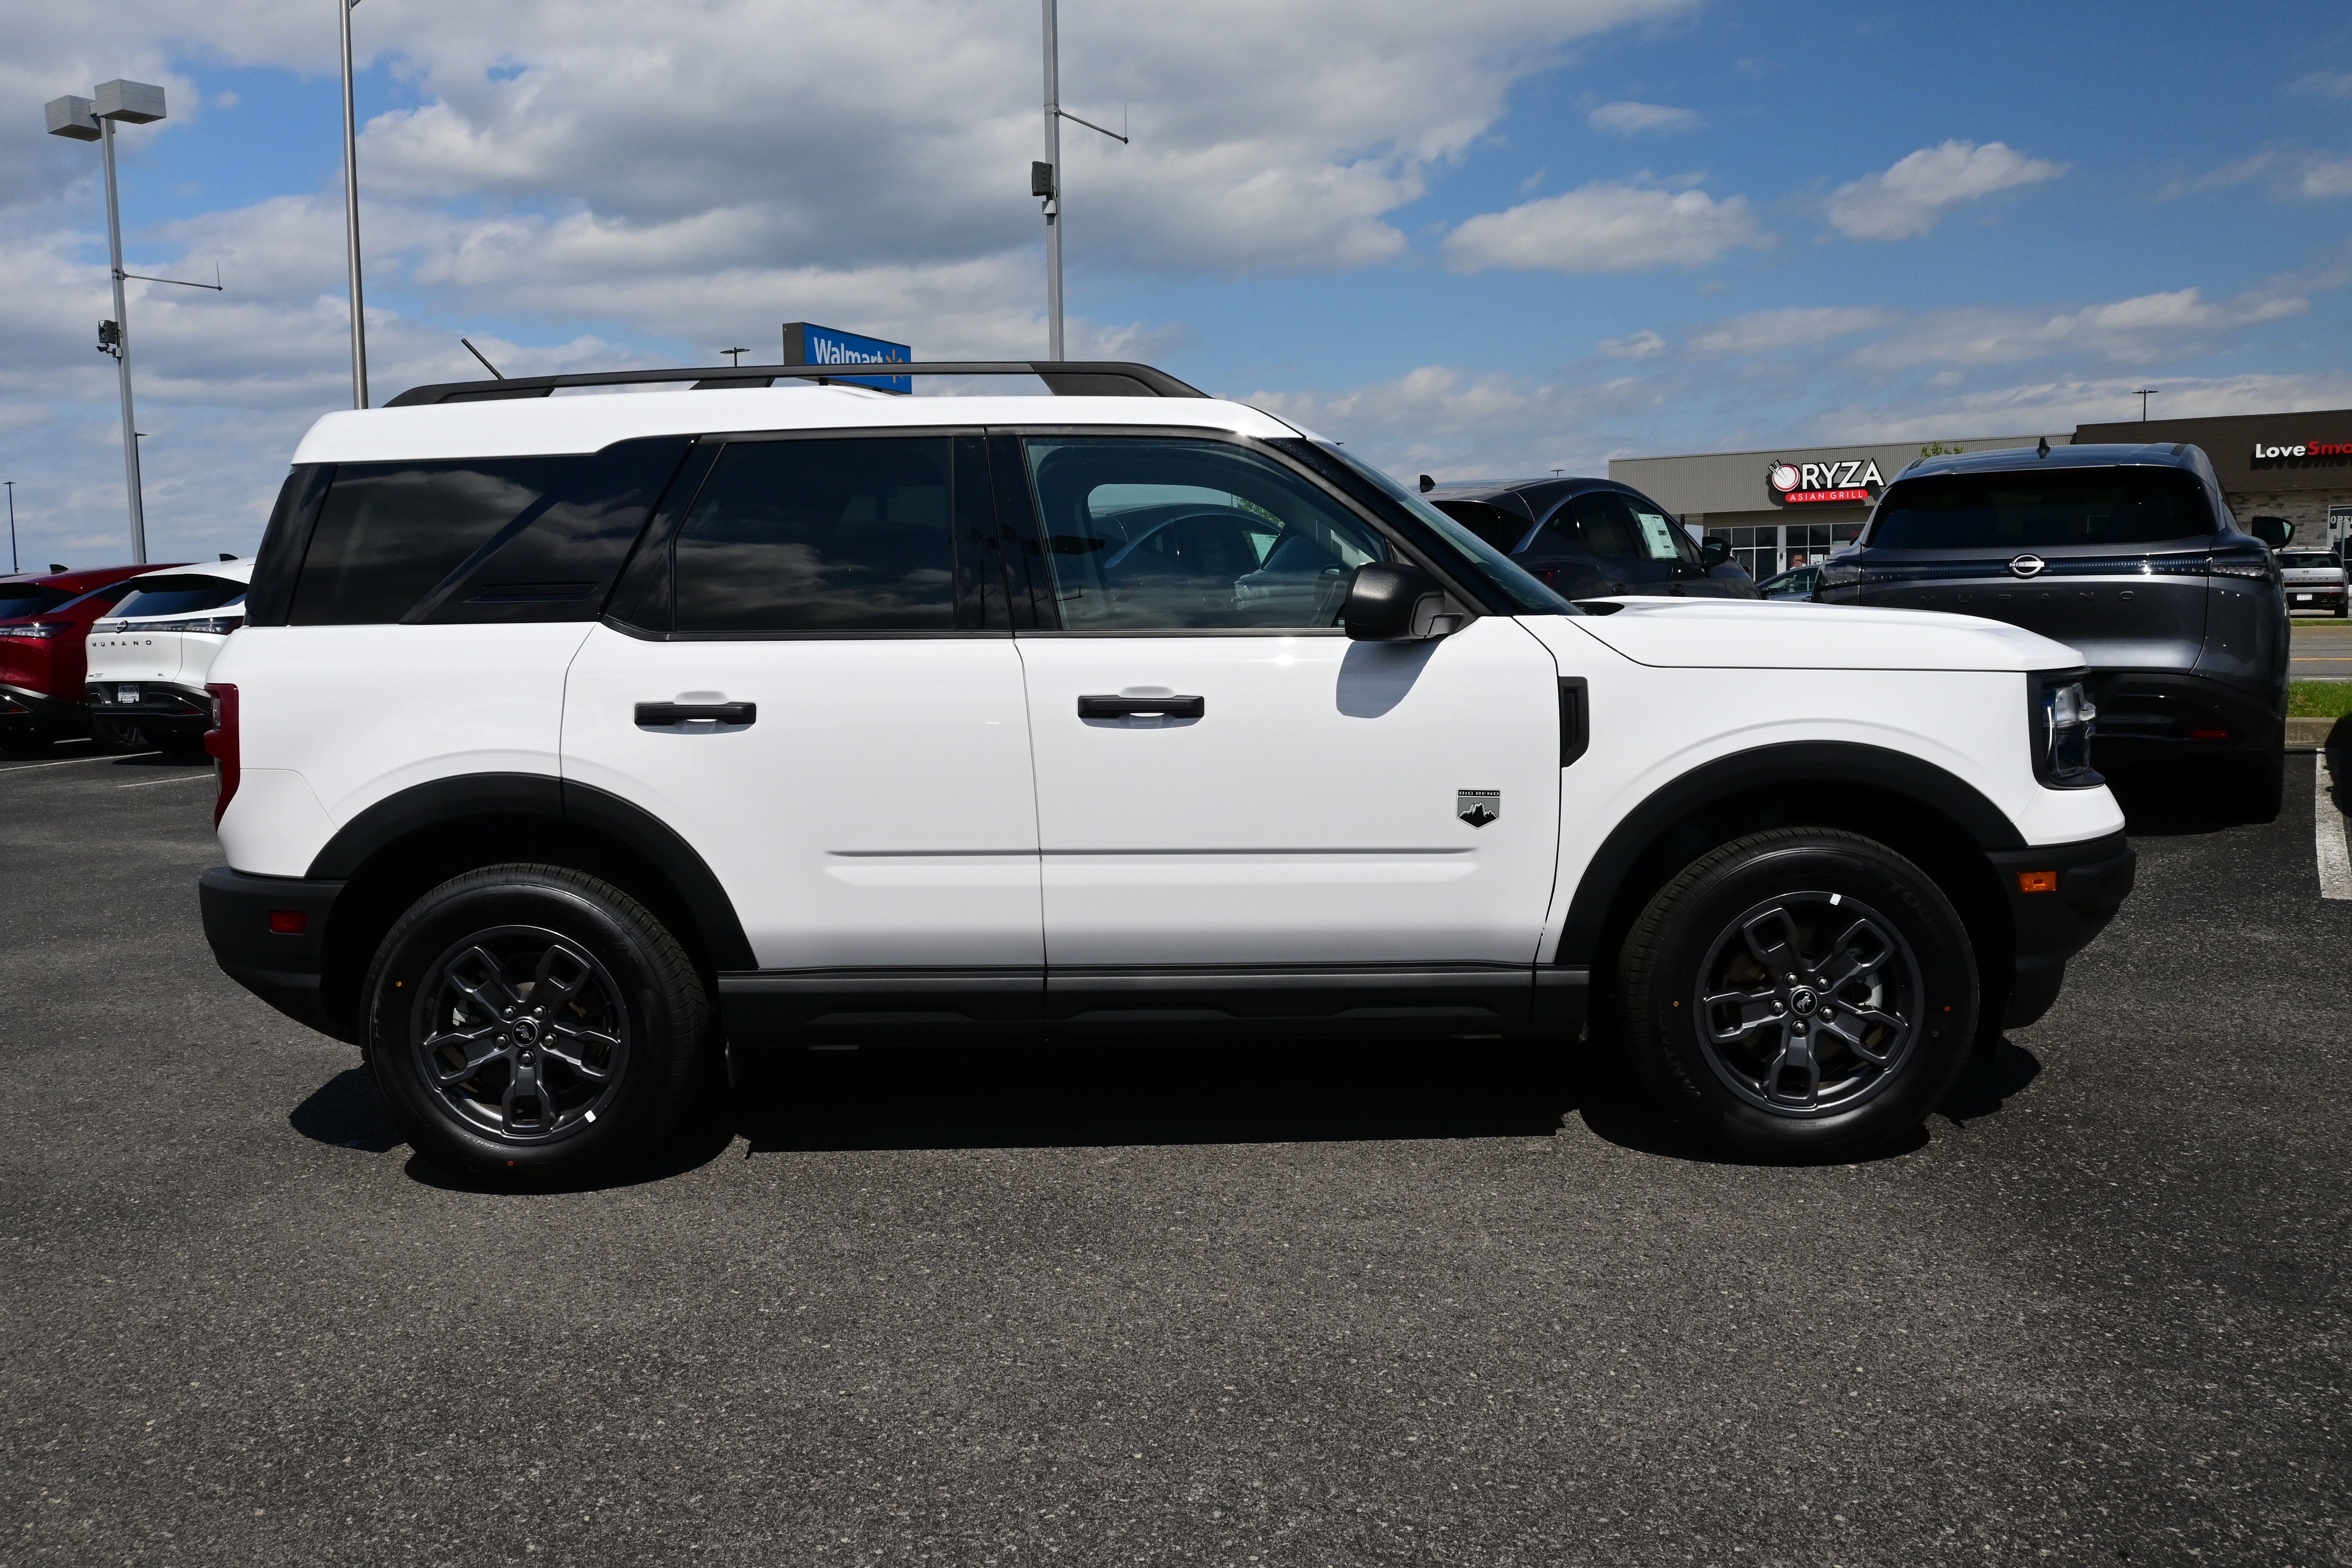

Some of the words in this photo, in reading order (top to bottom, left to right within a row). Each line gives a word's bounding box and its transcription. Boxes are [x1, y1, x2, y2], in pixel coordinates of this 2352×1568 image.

[1790, 493, 1825, 501] ASIAN
[1830, 491, 1863, 499] GRILL
[2330, 516, 2352, 524] OPE
[1920, 590, 2135, 604] MURANO
